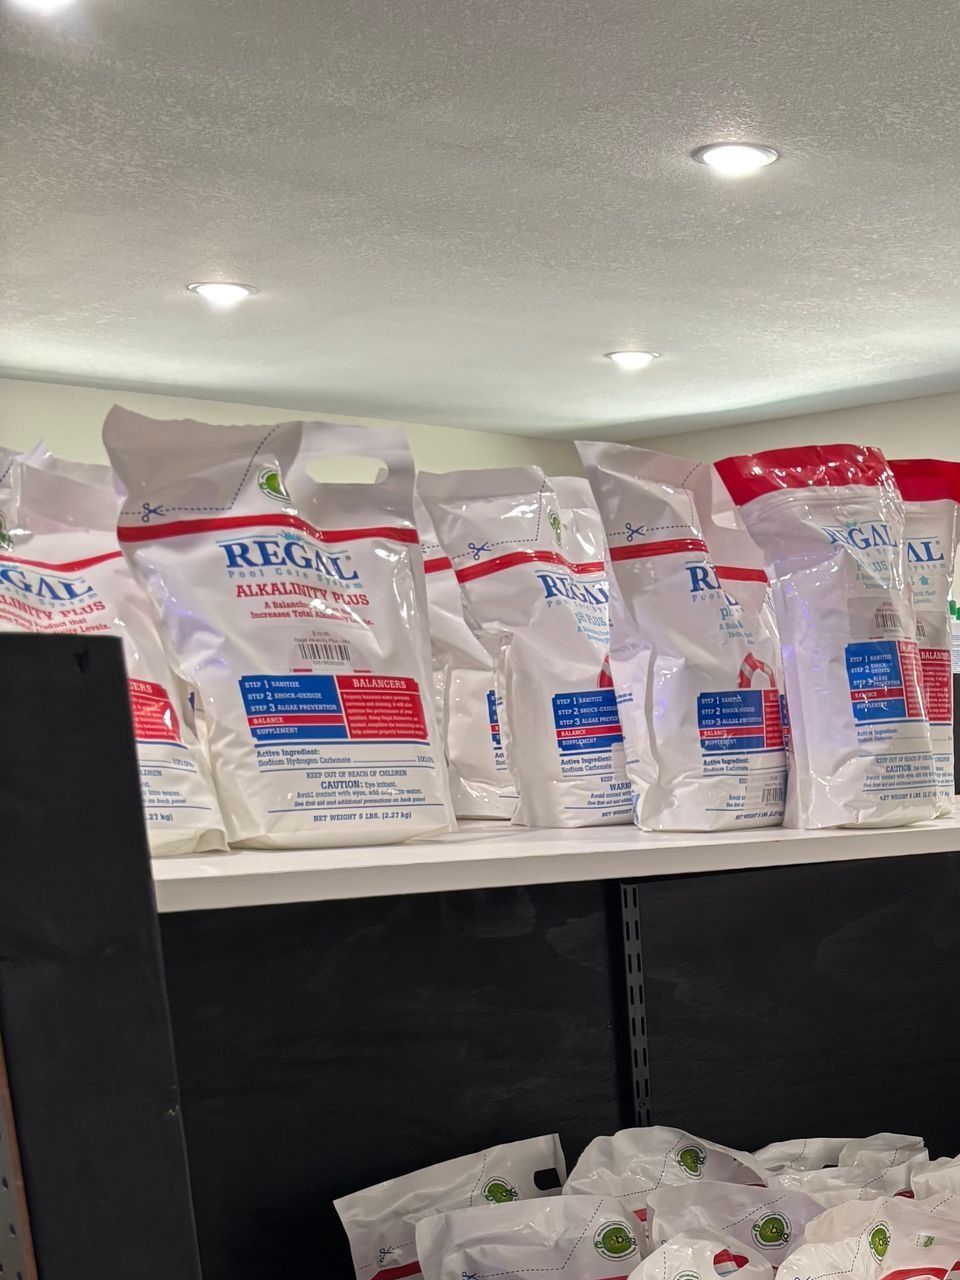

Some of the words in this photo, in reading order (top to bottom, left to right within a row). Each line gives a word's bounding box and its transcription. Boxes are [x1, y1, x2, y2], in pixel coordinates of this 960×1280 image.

[219, 541, 360, 581] REGAL
[236, 582, 328, 601] ALKALINITY
[331, 591, 370, 606] PLUS
[292, 611, 313, 619] Total
[264, 680, 269, 688] 1
[353, 679, 407, 688] BALANCERS
[266, 692, 272, 700] 2
[257, 749, 280, 757] Active
[282, 749, 320, 757] Ingredient:
[286, 758, 318, 766] Hydrogen
[321, 781, 363, 789] CAUTION:
